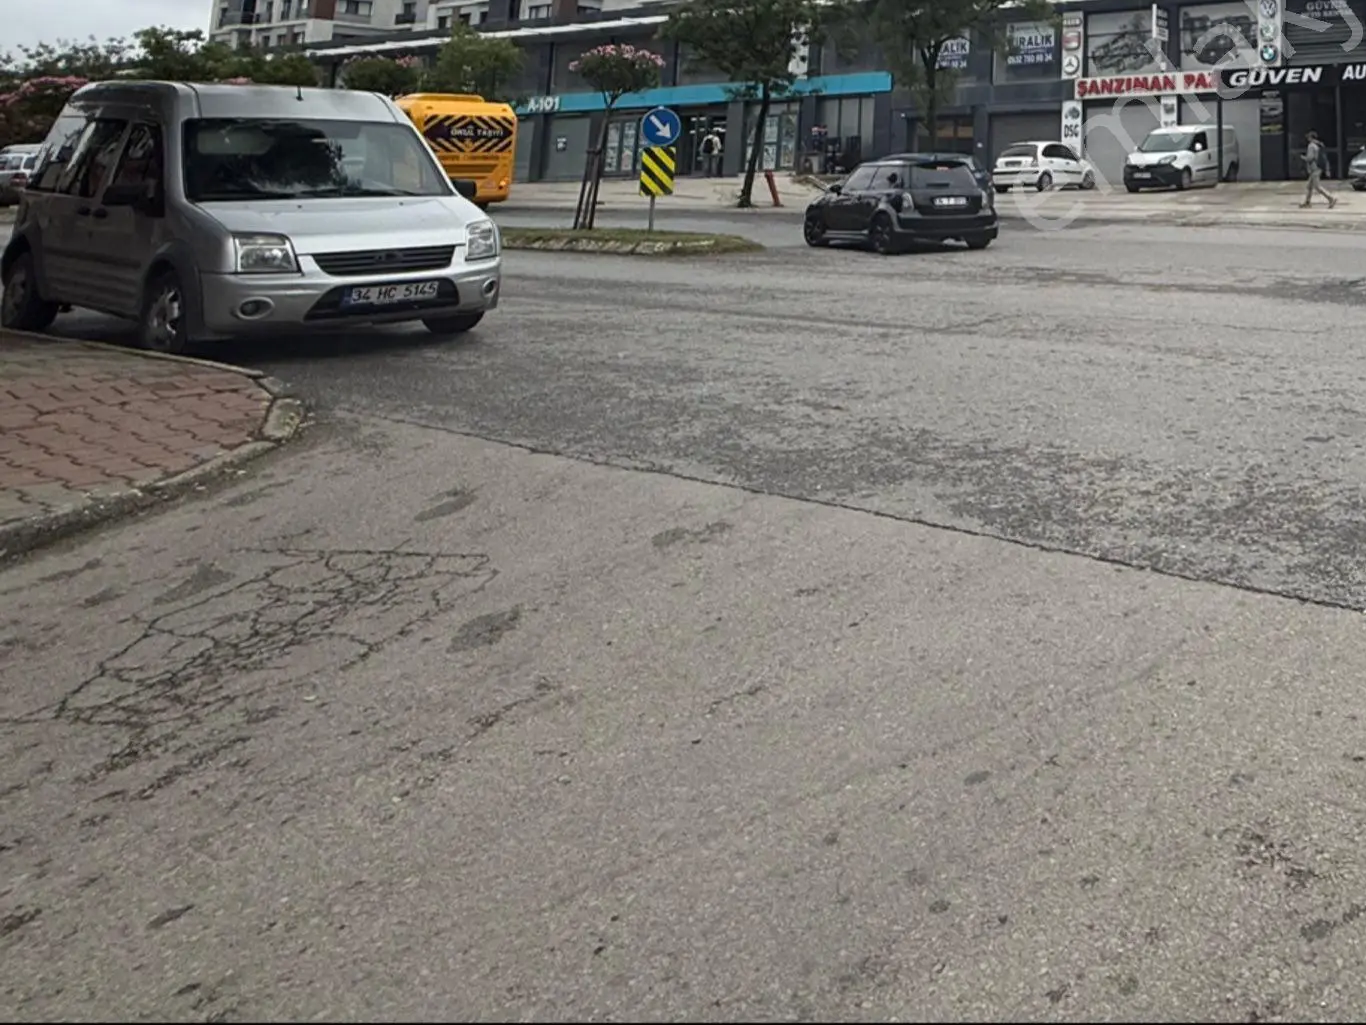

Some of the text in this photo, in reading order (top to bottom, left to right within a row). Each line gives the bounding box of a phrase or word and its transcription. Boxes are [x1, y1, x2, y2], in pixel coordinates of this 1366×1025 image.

[1229, 64, 1322, 86] GÜVEN
[1064, 124, 1080, 138] DSG
[353, 289, 371, 302] 34
[377, 287, 397, 299] HC
